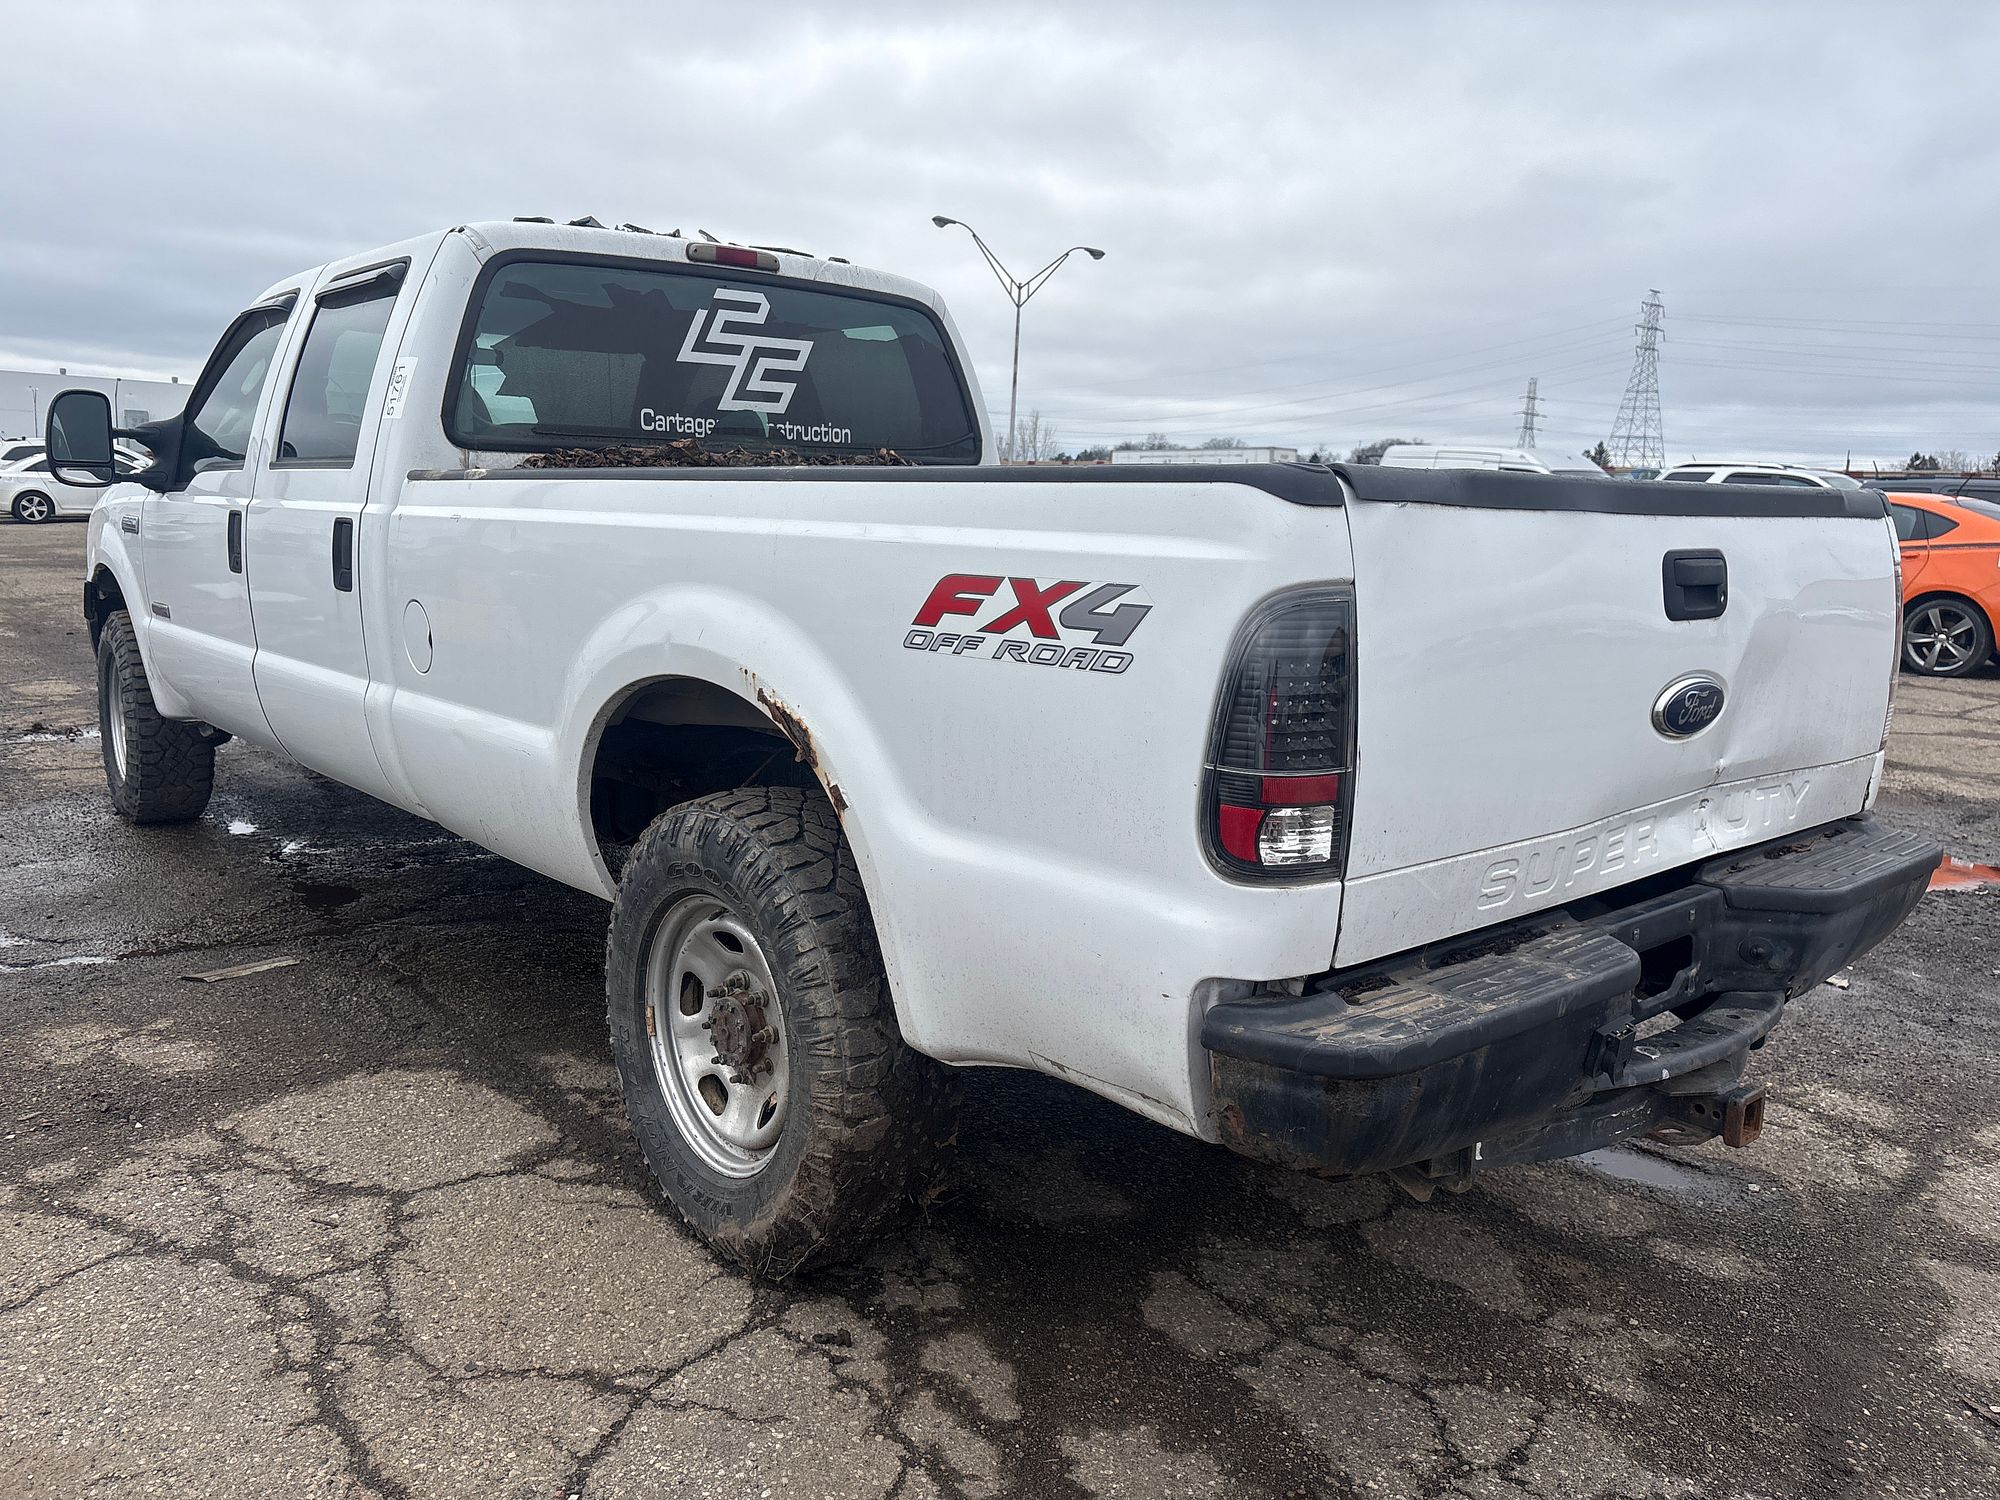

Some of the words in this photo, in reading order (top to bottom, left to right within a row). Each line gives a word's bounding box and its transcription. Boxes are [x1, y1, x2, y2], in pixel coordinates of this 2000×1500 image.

[640, 408, 720, 438] Cartage
[911, 573, 1154, 647] FX4
[902, 629, 986, 655] OFF
[991, 639, 1135, 674] ROAD
[1476, 815, 1660, 911] SUPER
